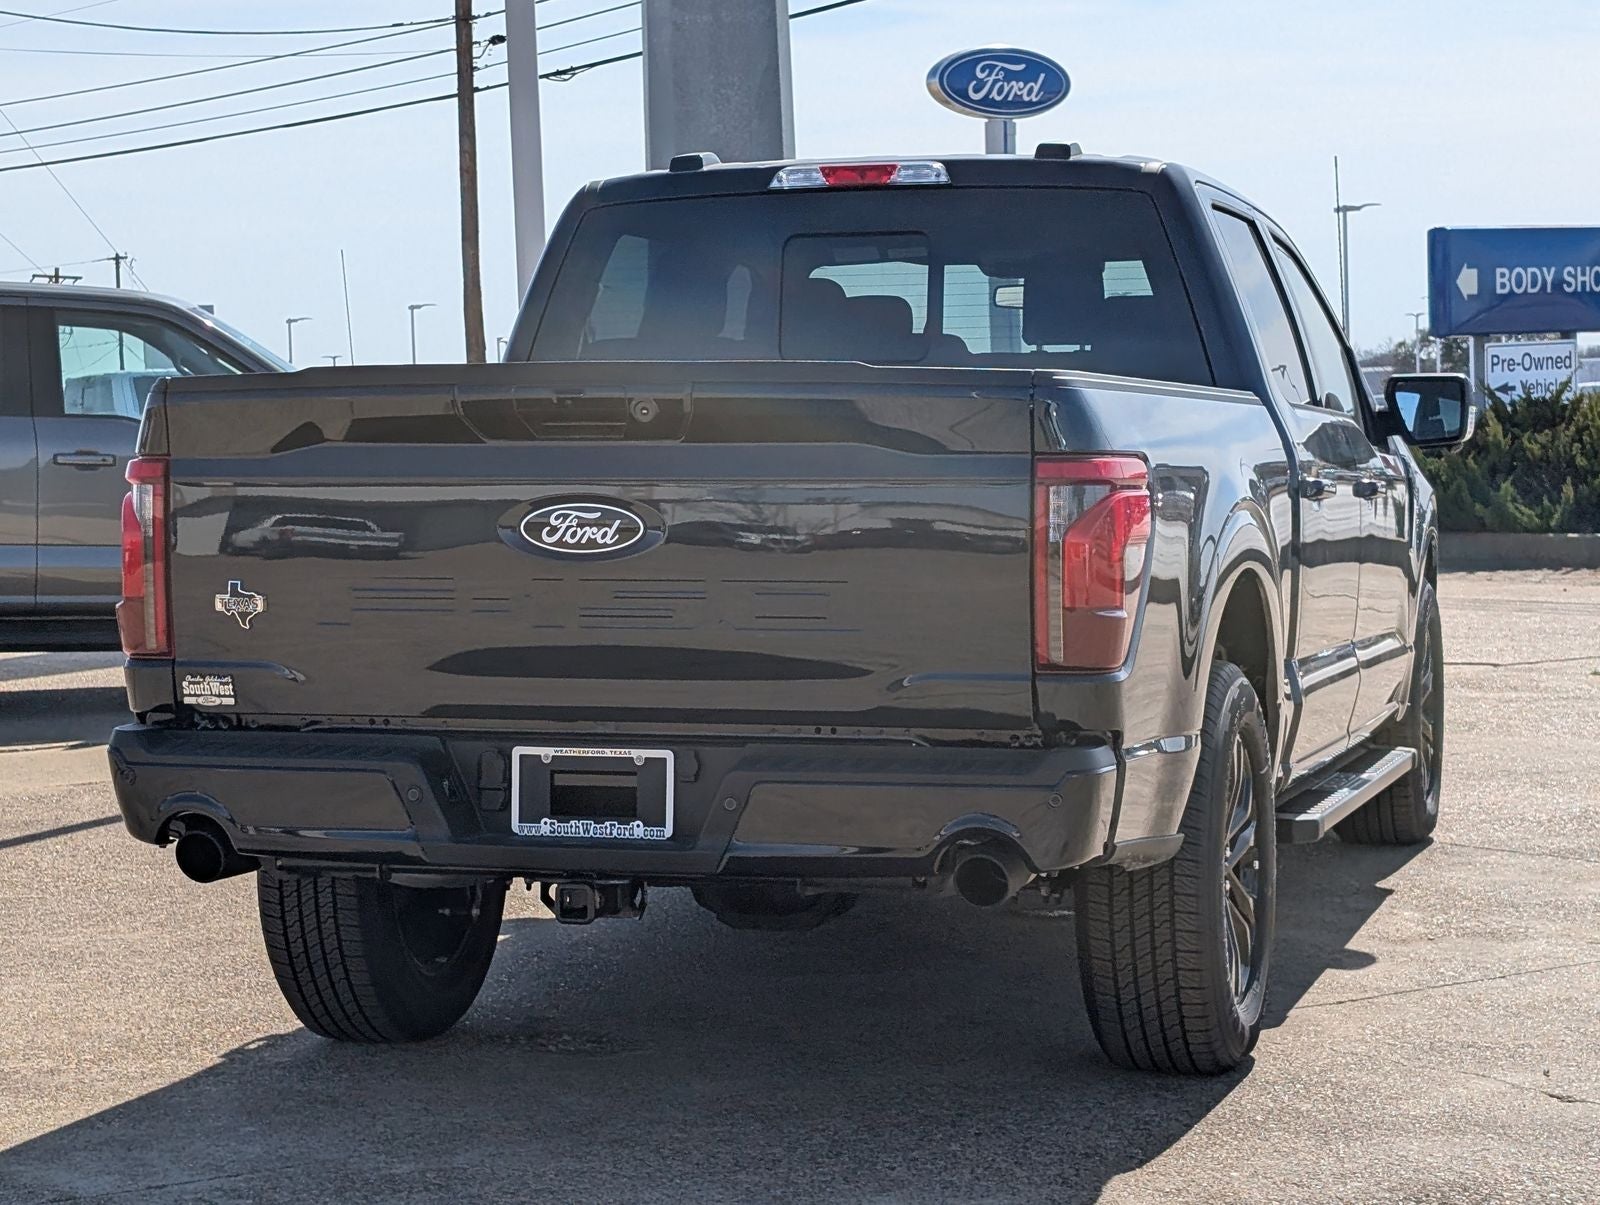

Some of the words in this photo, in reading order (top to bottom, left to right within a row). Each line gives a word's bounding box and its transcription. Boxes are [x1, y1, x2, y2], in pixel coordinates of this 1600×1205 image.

[968, 60, 1046, 102] Ford
[1496, 266, 1555, 294] BODY
[1490, 350, 1572, 373] Pre-Owned
[1520, 377, 1573, 396] Vehicls
[541, 510, 621, 545] Ford
[218, 597, 259, 609] TEXAS
[182, 681, 234, 695] SouthWest
[517, 820, 666, 838] www.SouthWestFord.com
